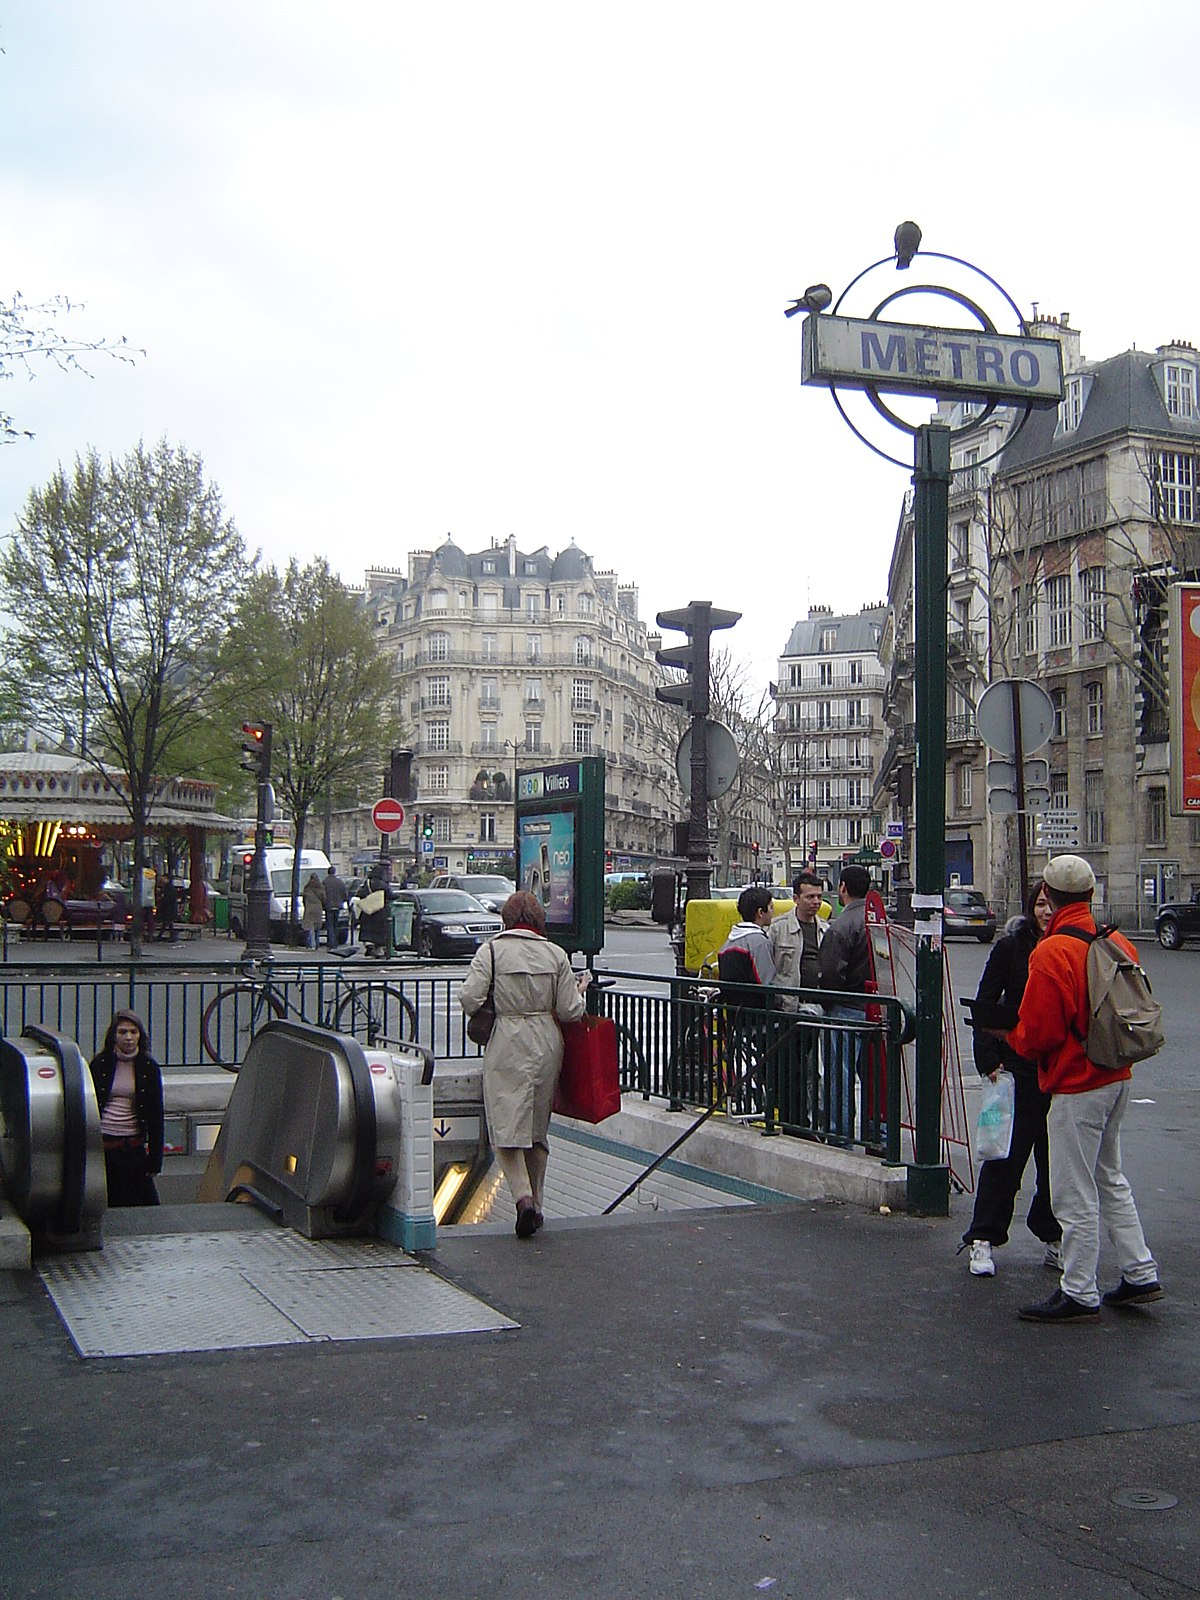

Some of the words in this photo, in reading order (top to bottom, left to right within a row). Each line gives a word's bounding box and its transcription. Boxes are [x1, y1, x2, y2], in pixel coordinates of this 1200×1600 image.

[545, 773, 570, 791] Villiers
[425, 842, 432, 851] P
[553, 850, 569, 865] neo
